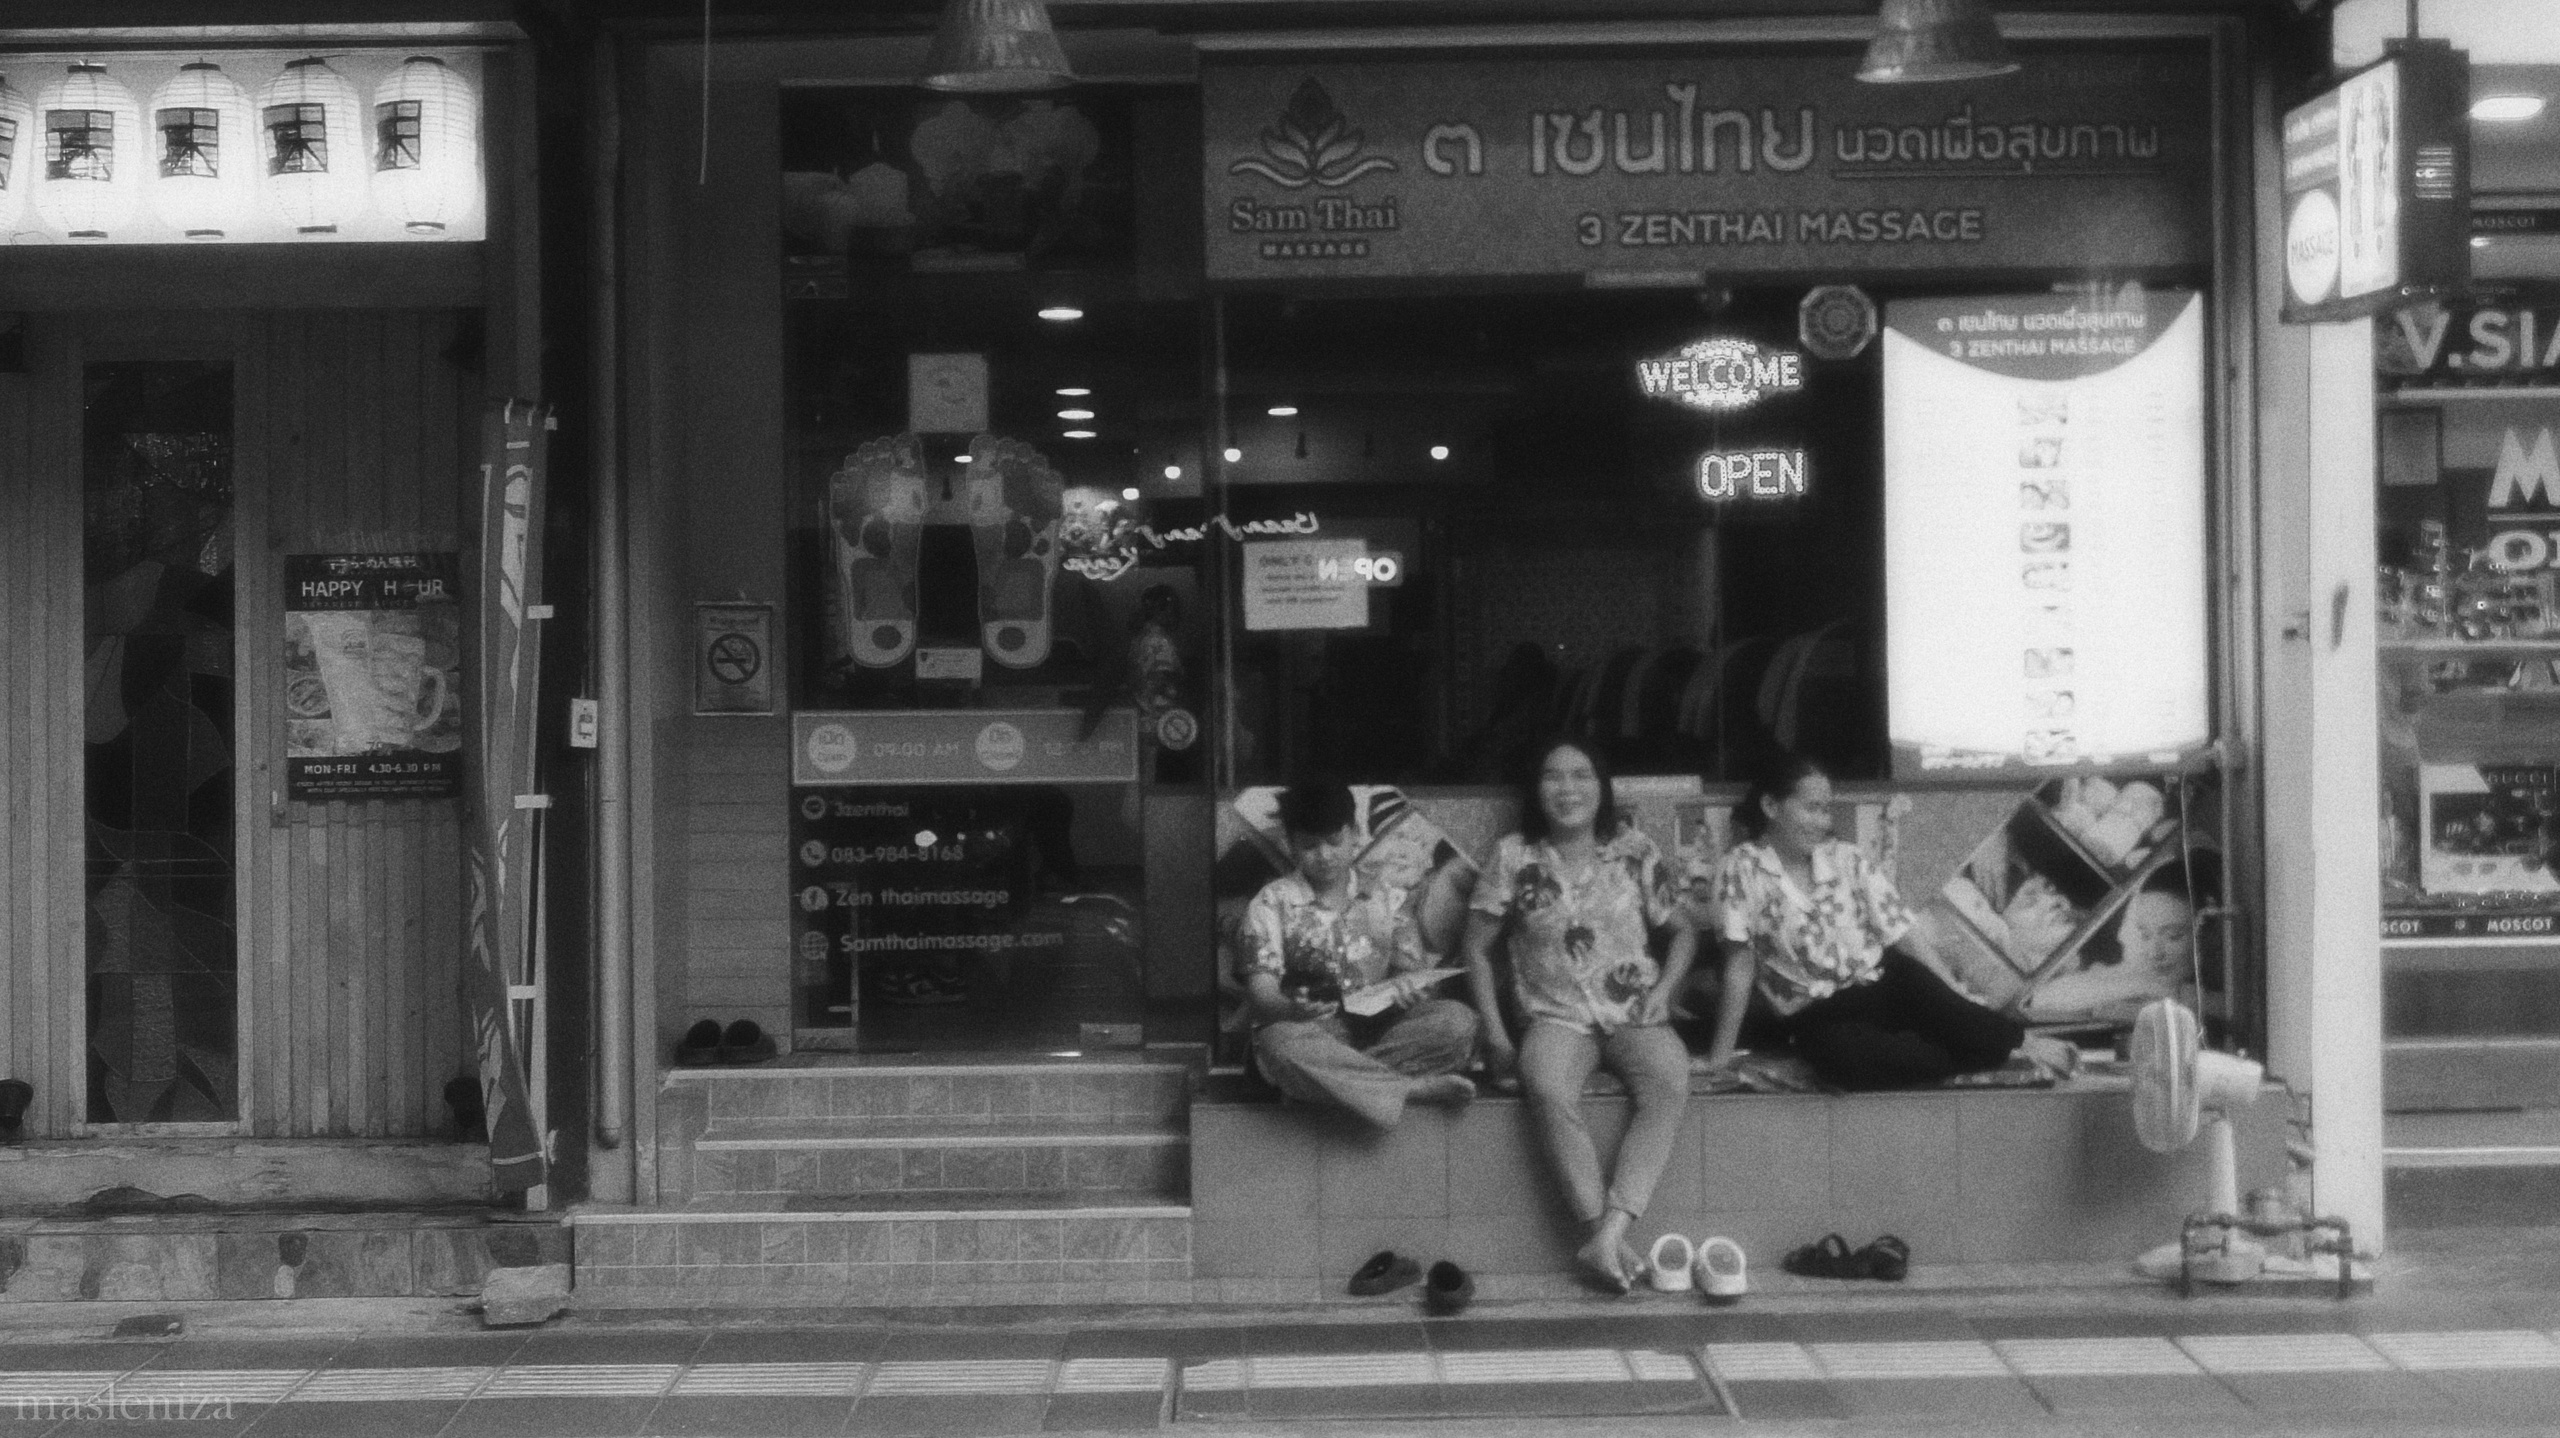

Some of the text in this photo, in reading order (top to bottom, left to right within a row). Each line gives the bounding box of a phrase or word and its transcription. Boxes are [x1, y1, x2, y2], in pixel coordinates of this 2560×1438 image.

[1836, 103, 2158, 174] นวดเพื่อสุขภาพ
[1232, 198, 1397, 230] Sam Thai
[1579, 211, 1981, 245] 3 ZENTHAI MASSAGE
[1968, 339, 2047, 358] ZENTHAI
[2050, 336, 2136, 355] MASSAGE
[1639, 354, 1800, 393] WELCOME
[1701, 452, 1804, 496] OPEN
[301, 578, 444, 597] HAPPY HUR
[304, 763, 357, 775] MON-FRI
[836, 886, 1010, 909] Zen thaimassage
[2487, 916, 2553, 932] MOSCOT
[840, 932, 1065, 953] Samthaimassage.com
